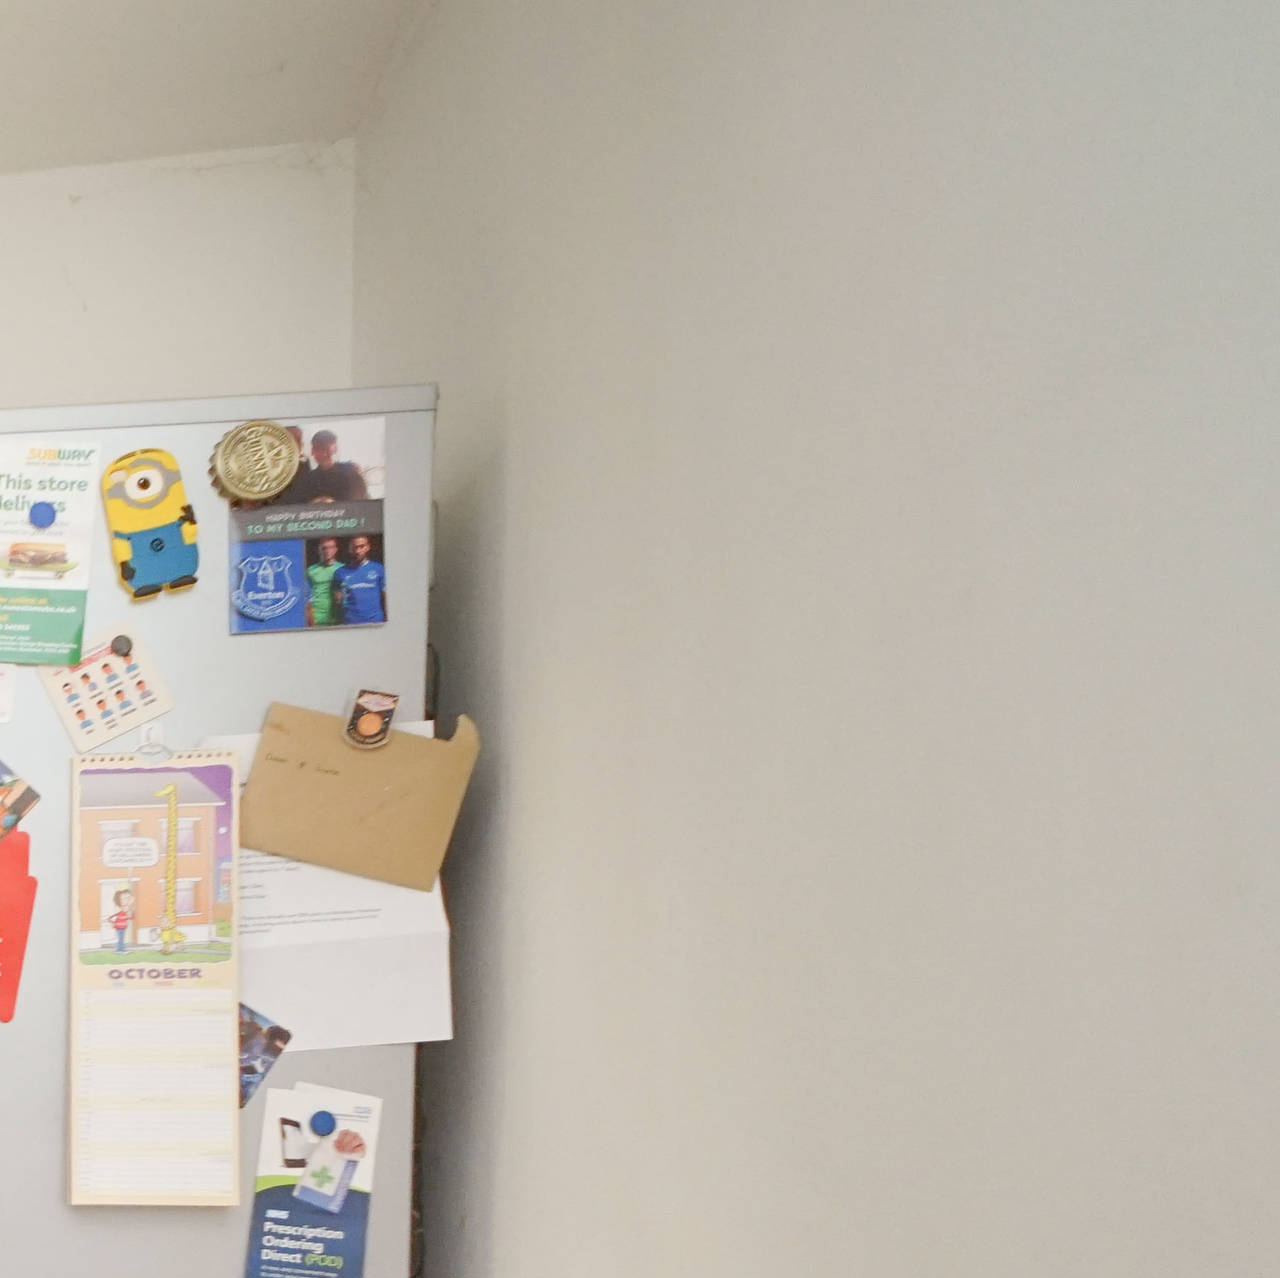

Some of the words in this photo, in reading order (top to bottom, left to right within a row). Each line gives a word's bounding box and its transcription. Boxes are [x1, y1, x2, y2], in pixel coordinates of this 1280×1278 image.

[26, 447, 95, 461] SUBWAY
[37, 475, 89, 492] store
[247, 524, 263, 535] TO
[266, 522, 283, 534] MY
[335, 518, 359, 529] DAD
[247, 591, 285, 600] Everton
[107, 967, 203, 980] OCTOBER
[263, 1221, 345, 1239] Prescription
[262, 1235, 325, 1254] Ordering
[261, 1248, 303, 1264] Direct
[304, 1253, 344, 1269] (POD)
